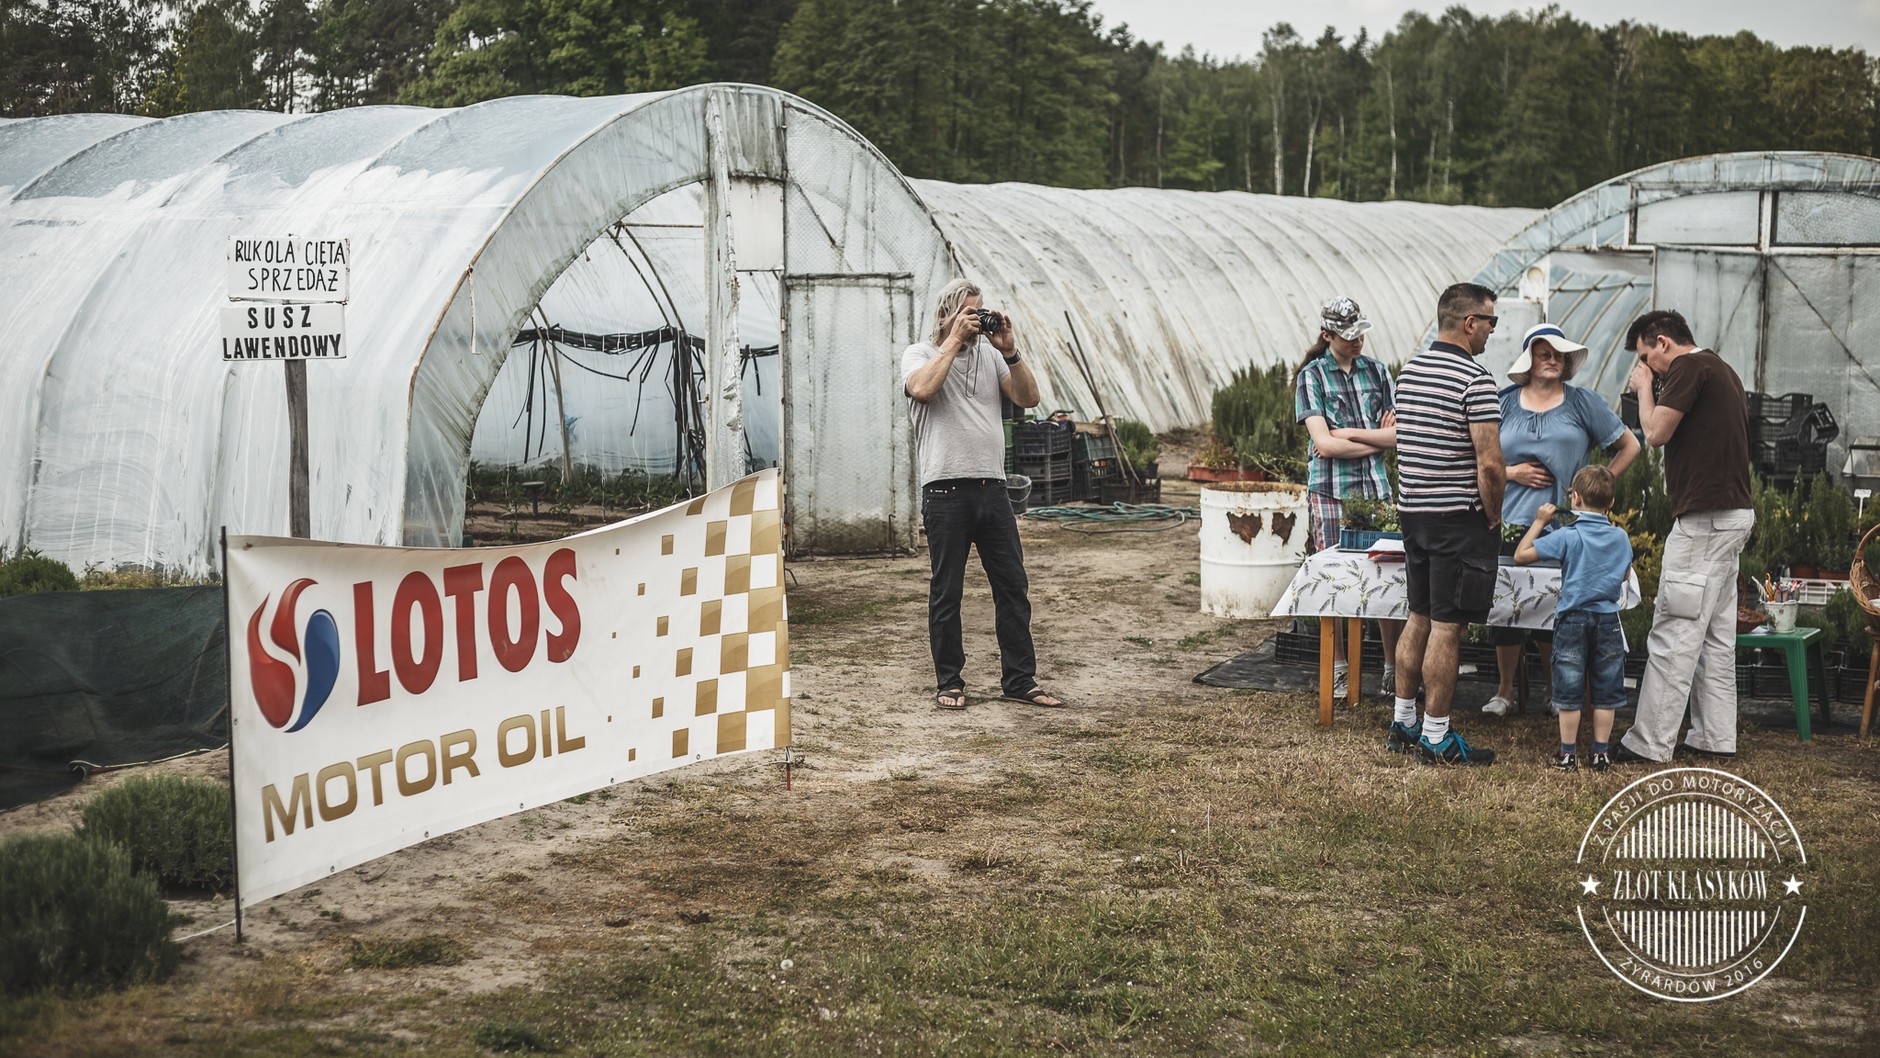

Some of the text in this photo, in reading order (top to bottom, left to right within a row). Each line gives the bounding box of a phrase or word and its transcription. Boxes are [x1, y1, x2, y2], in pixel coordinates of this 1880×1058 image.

[235, 240, 346, 267] RUKOLA CIĘTA
[222, 333, 342, 359] LAWENDOWY
[352, 547, 581, 707] LOTOS
[261, 705, 586, 844] MOTOR OIL
